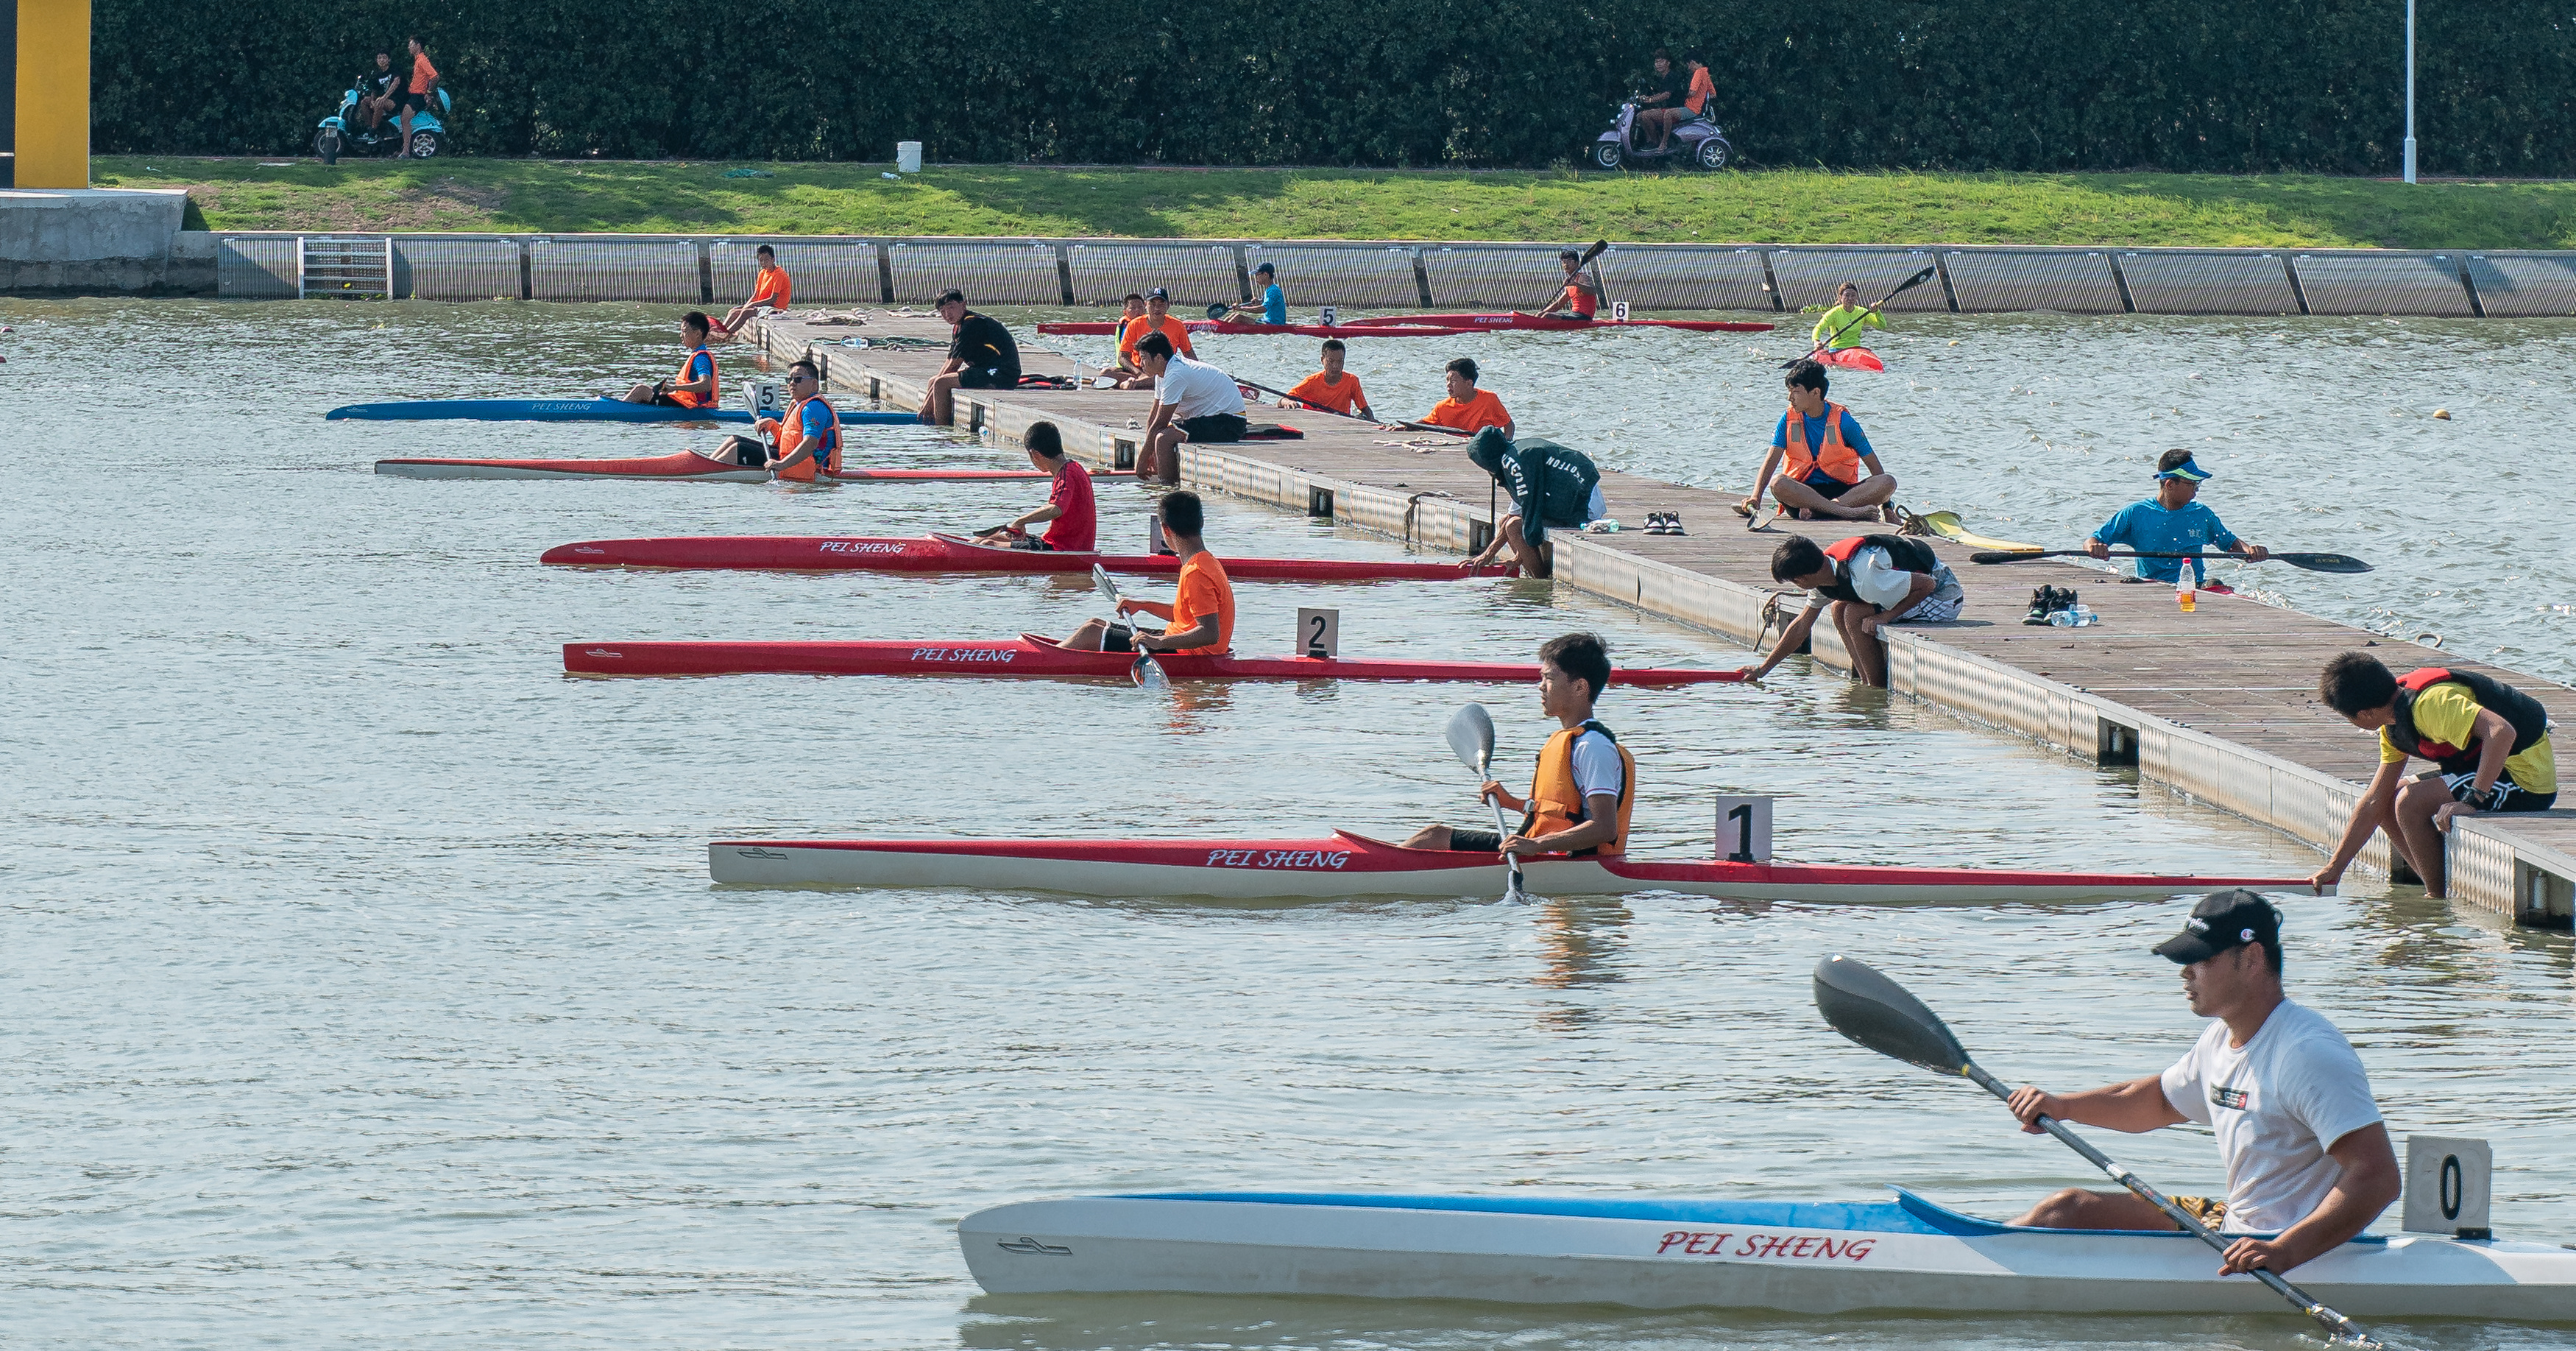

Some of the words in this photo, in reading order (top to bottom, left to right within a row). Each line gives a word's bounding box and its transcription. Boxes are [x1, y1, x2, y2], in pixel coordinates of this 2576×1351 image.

[1323, 308, 1333, 325] 5
[1616, 303, 1625, 317] 6
[762, 386, 774, 405] 5
[553, 403, 592, 411] SHENG
[819, 541, 851, 551] PEI
[850, 543, 906, 554] SHENG
[1309, 616, 1326, 648] 2
[910, 648, 948, 660] PEI
[949, 649, 1017, 663] SHENG
[1729, 804, 1752, 854] 1
[1206, 850, 1257, 866] PEI
[1259, 850, 1351, 869] SHENG
[2439, 1154, 2461, 1220] 0
[1656, 1230, 1733, 1255] PEI
[1735, 1234, 1876, 1261] SHENG
